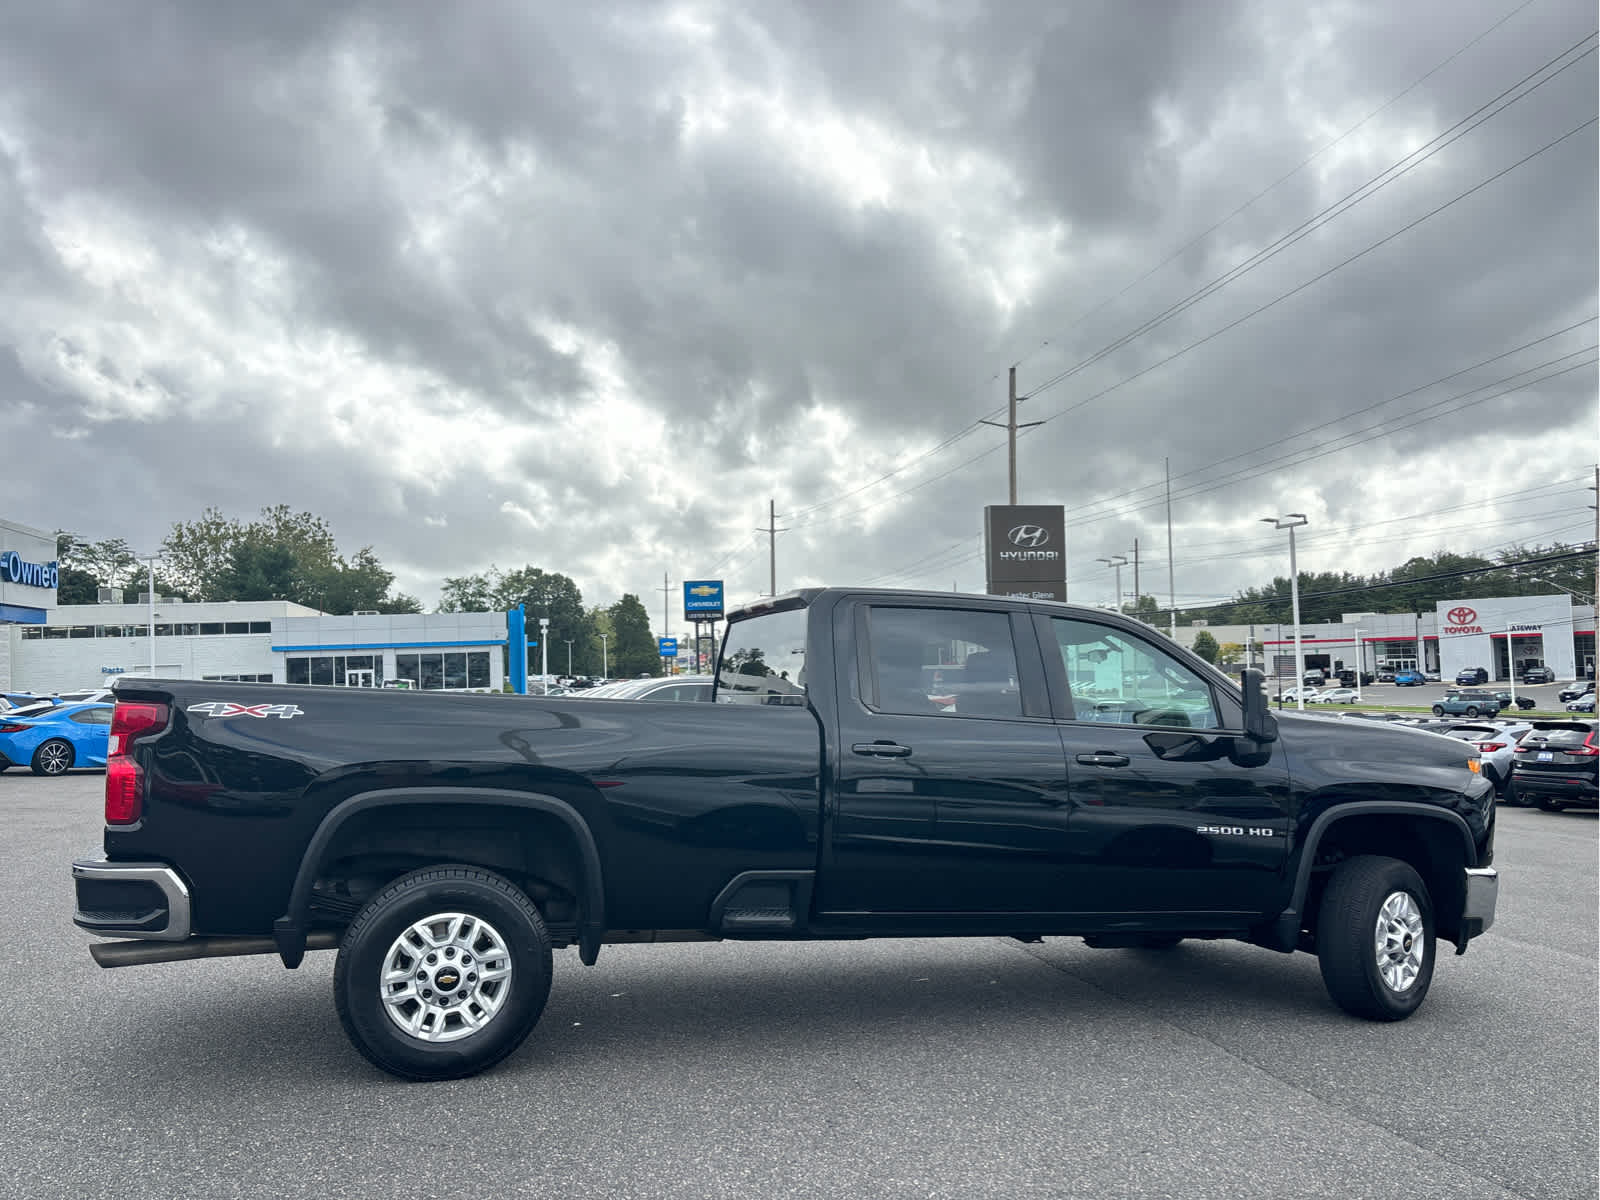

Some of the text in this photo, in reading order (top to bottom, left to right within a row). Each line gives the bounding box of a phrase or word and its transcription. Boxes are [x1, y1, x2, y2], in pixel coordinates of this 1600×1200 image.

[1000, 551, 1058, 561] HYUNDAI
[1444, 625, 1483, 634] TOYOTA
[1510, 624, 1542, 632] ATEWAY
[101, 665, 125, 674] Parts
[1196, 826, 1273, 837] 2500 HD
